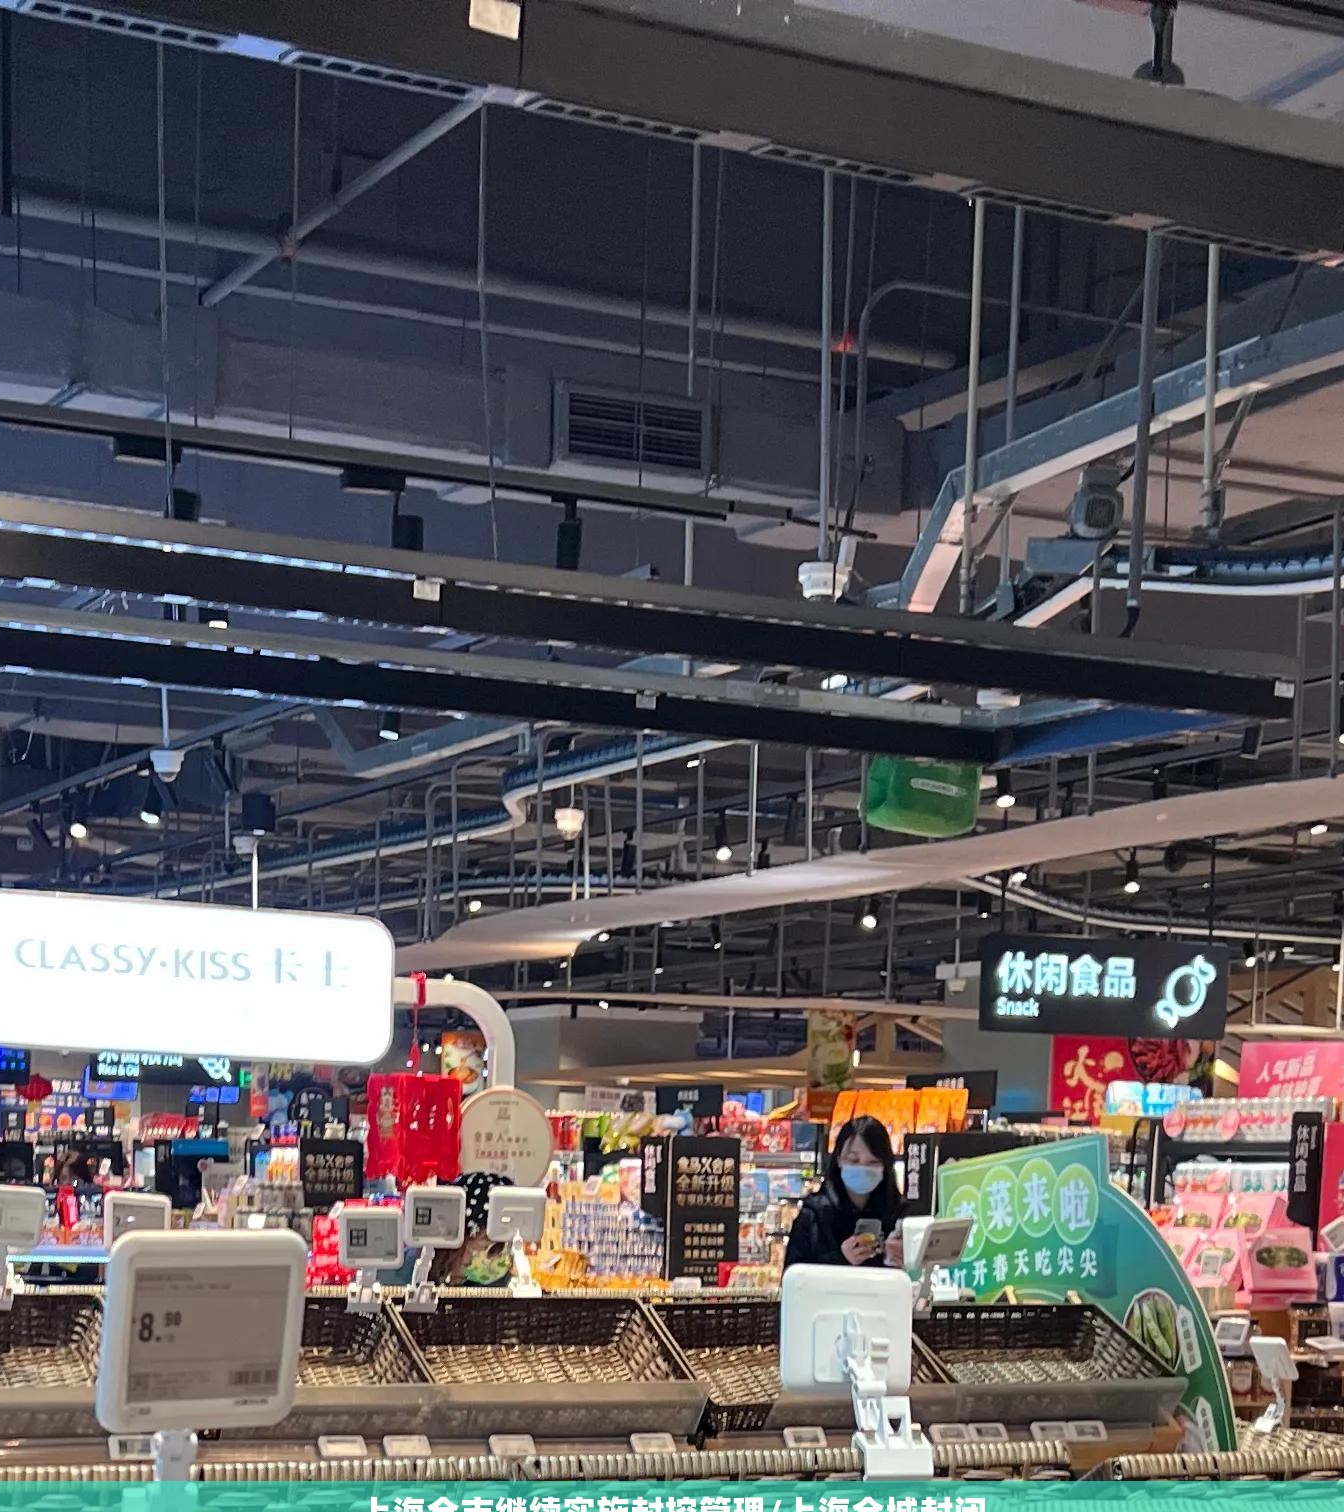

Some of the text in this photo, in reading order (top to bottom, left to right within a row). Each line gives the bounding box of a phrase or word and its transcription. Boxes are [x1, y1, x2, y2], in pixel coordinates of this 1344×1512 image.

[997, 950, 1138, 1000] 休闲食品
[995, 996, 1041, 1018] Snack
